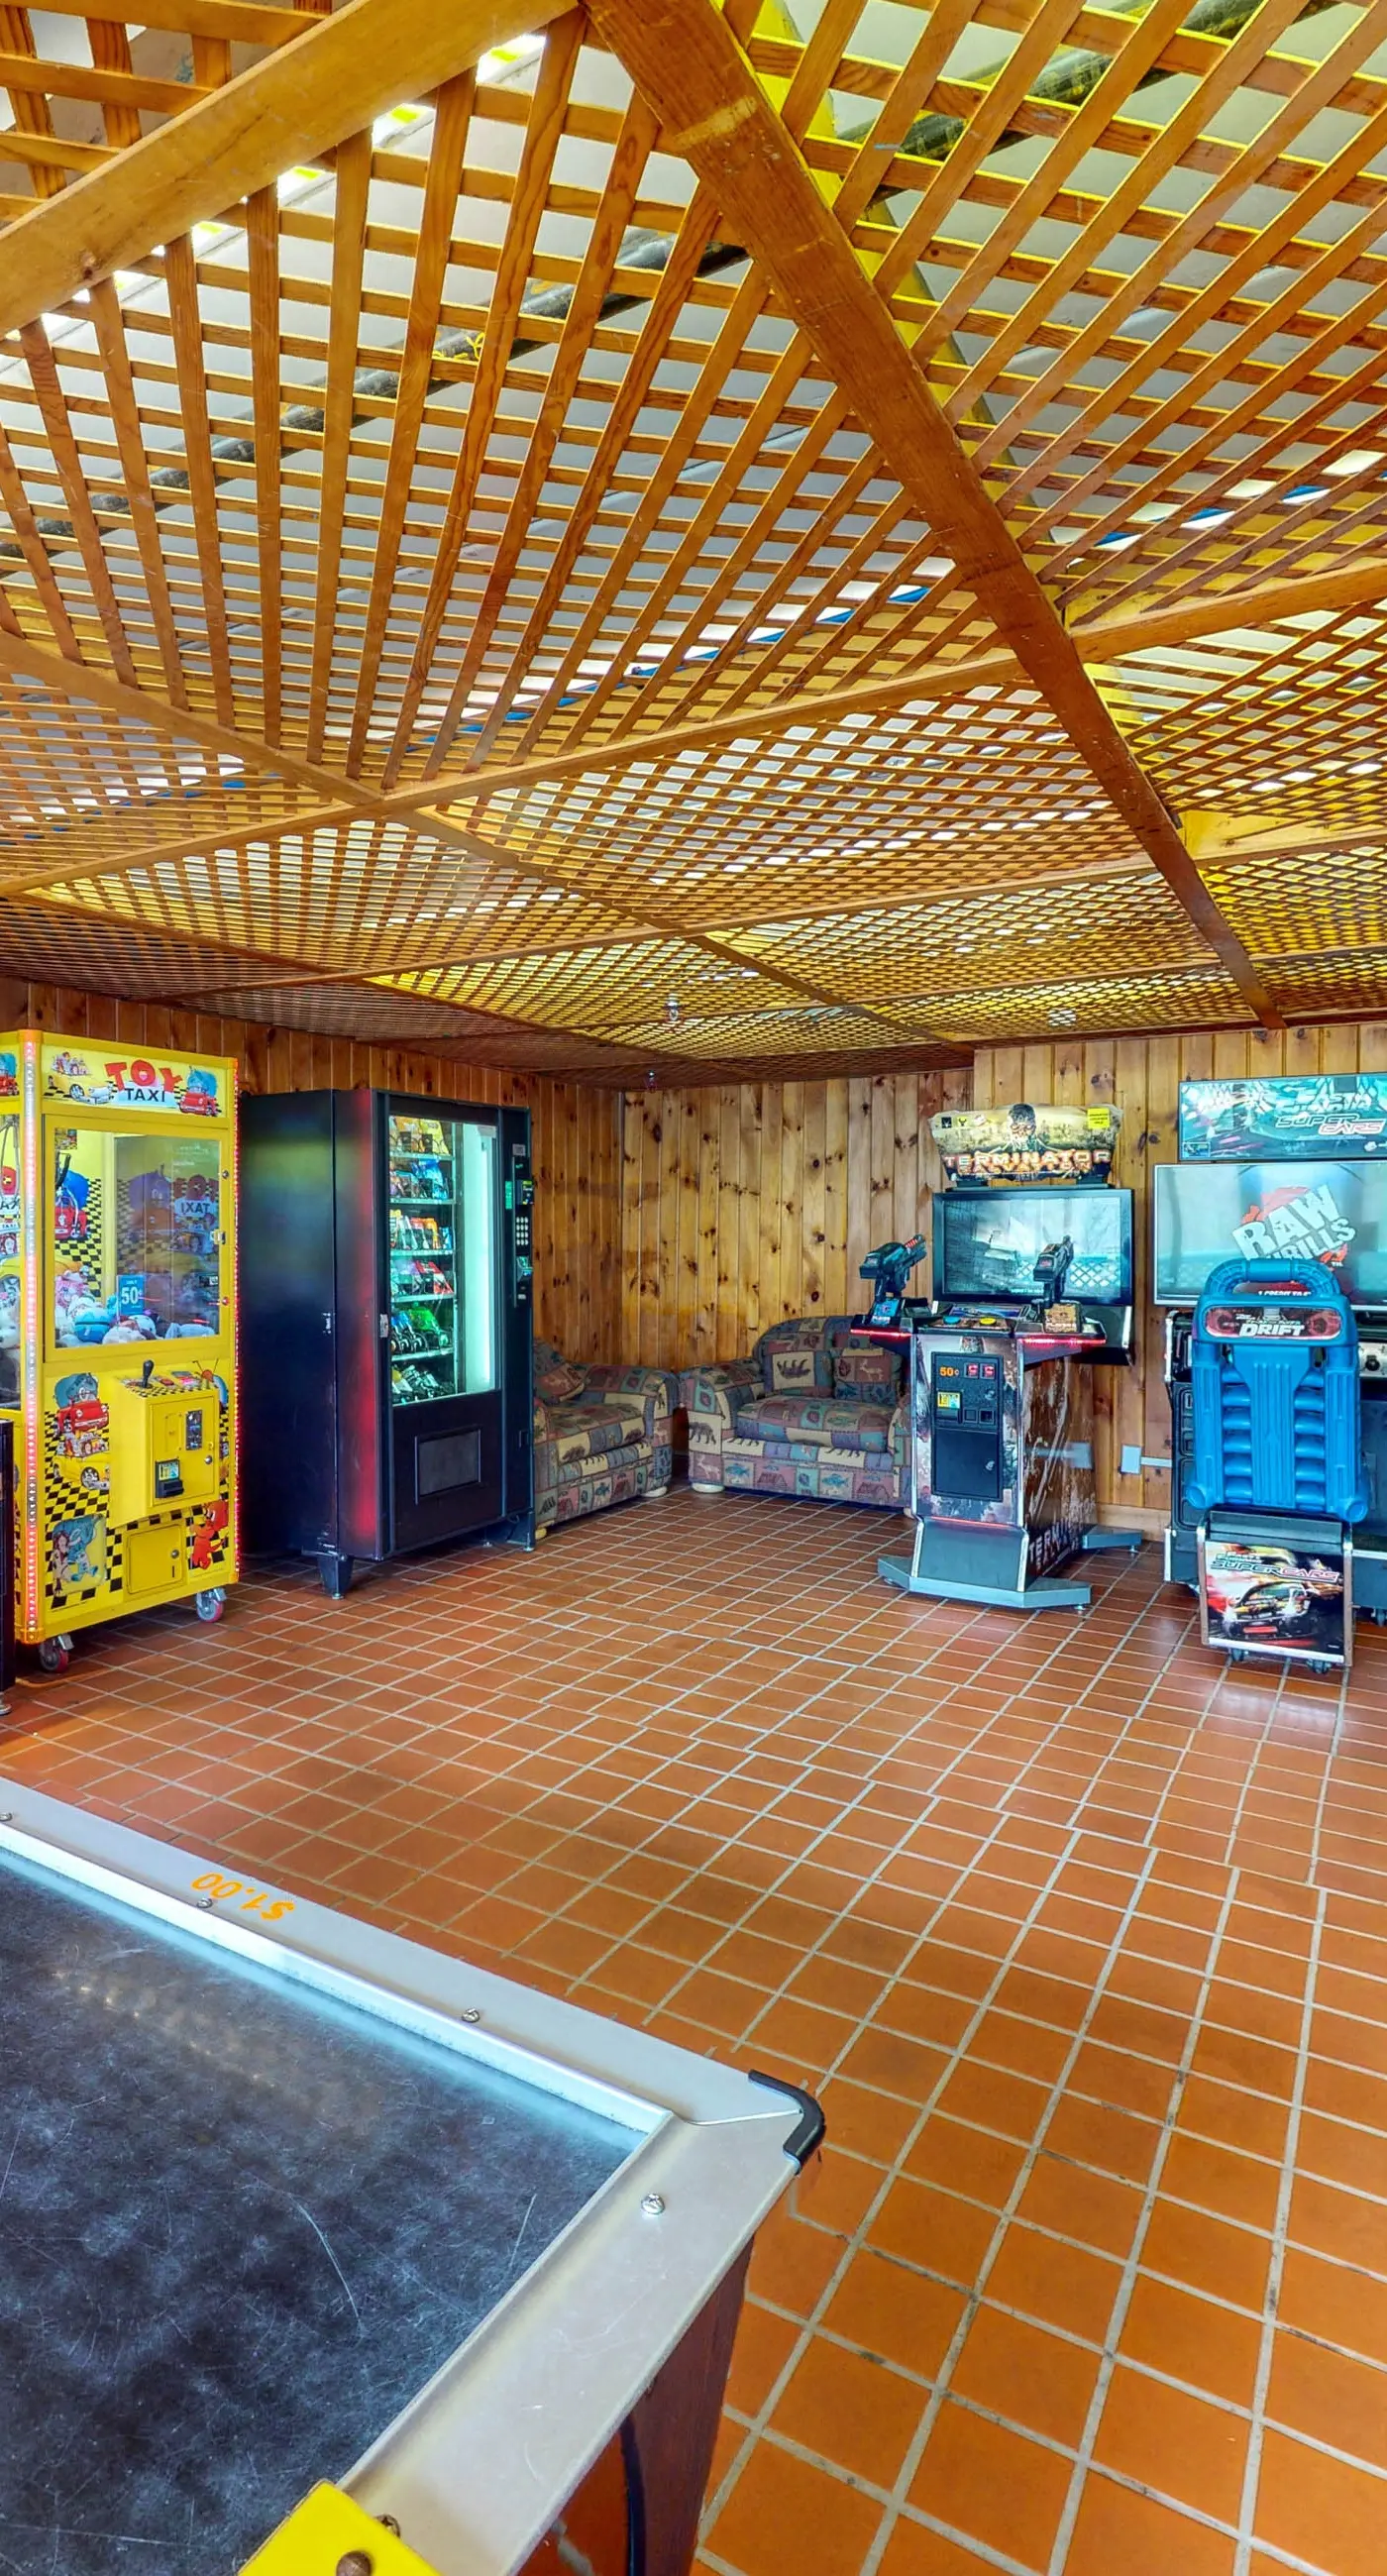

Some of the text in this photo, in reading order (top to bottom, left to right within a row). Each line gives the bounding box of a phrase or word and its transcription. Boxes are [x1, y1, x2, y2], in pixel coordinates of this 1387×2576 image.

[104, 1059, 183, 1093] TOY
[124, 1088, 165, 1102] TAXI
[1275, 1113, 1360, 1127] SUPER
[1318, 1118, 1386, 1135] CARS
[942, 1149, 1112, 1167] TERMINATOR
[1231, 1184, 1340, 1260] RAW
[1266, 1217, 1356, 1260] RILLS
[1238, 1323, 1305, 1337] DRIFT
[190, 1872, 295, 1921] $1.00
